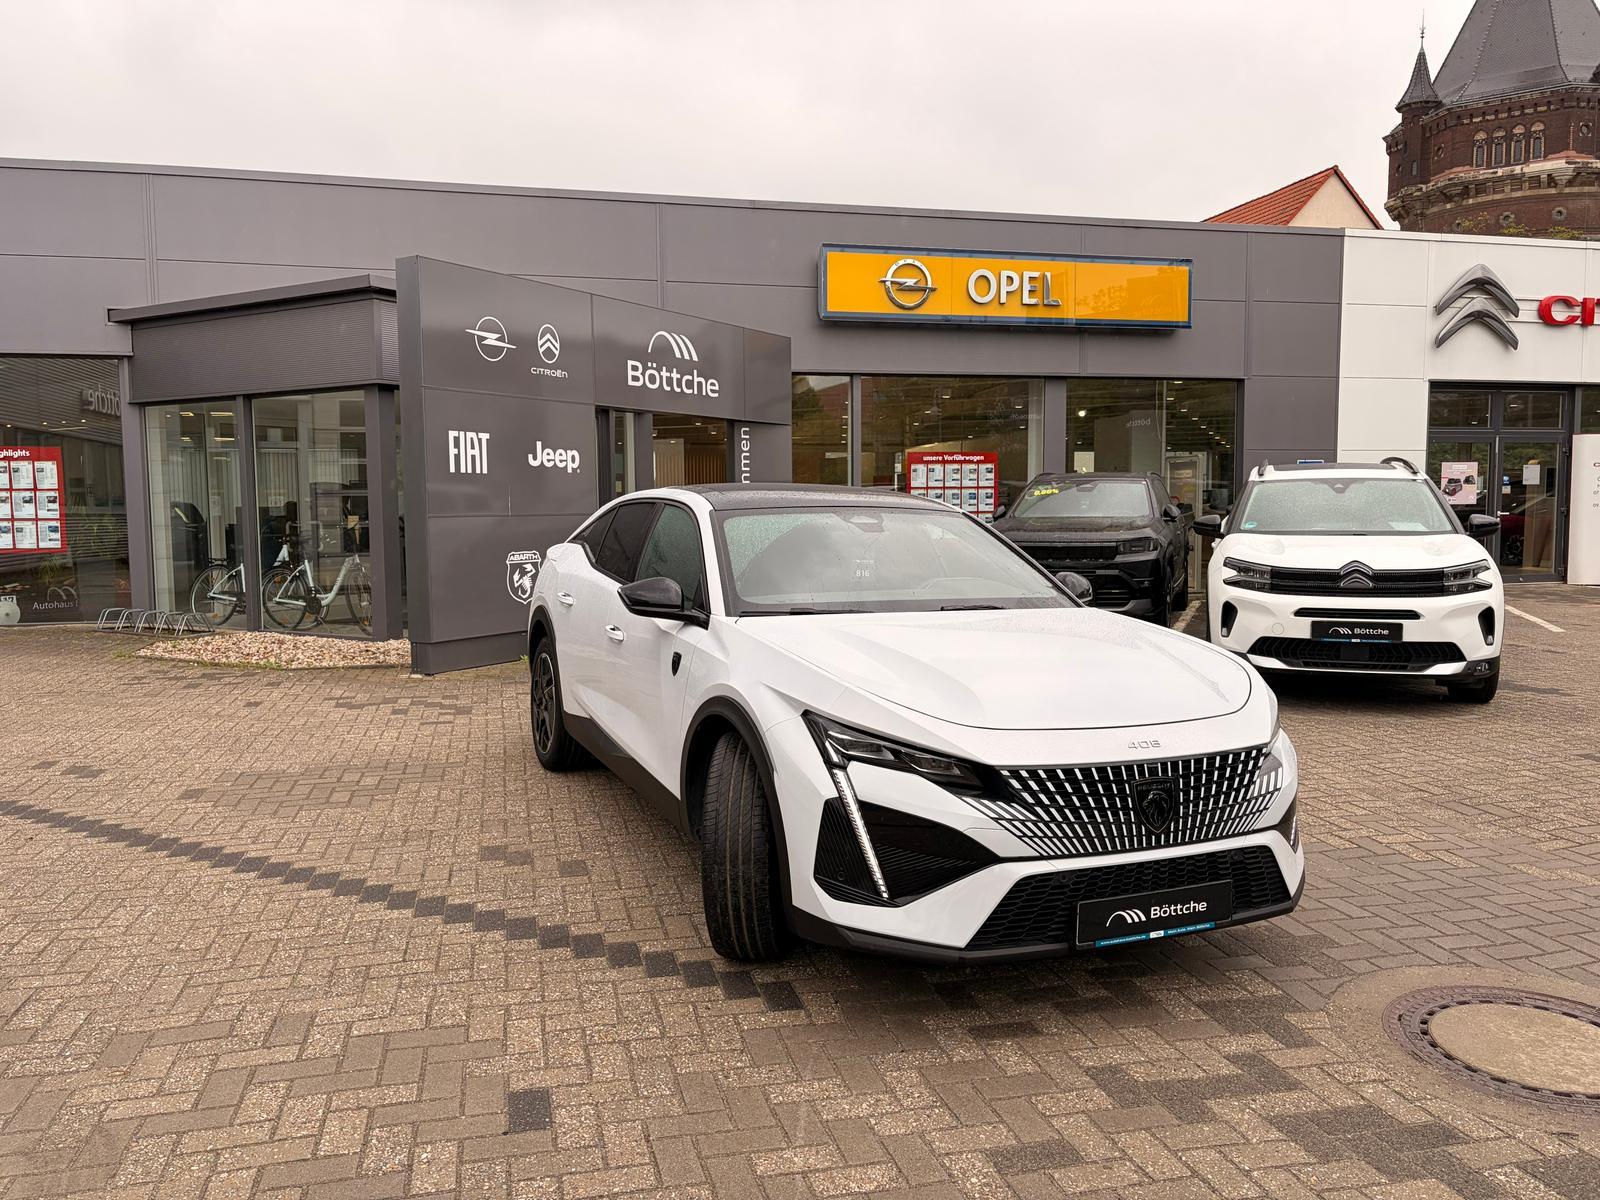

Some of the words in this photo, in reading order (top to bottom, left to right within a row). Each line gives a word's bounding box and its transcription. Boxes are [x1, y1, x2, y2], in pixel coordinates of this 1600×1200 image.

[967, 268, 1062, 306] OPEL
[1538, 295, 1600, 327] CI
[627, 359, 719, 398] Böttche
[448, 430, 490, 474] FIAT
[527, 440, 580, 473] Jeep
[509, 553, 538, 561] ABARTH
[32, 600, 74, 610] Autohaus
[1353, 627, 1390, 635] Böttche
[1150, 900, 1208, 919] Böttche
